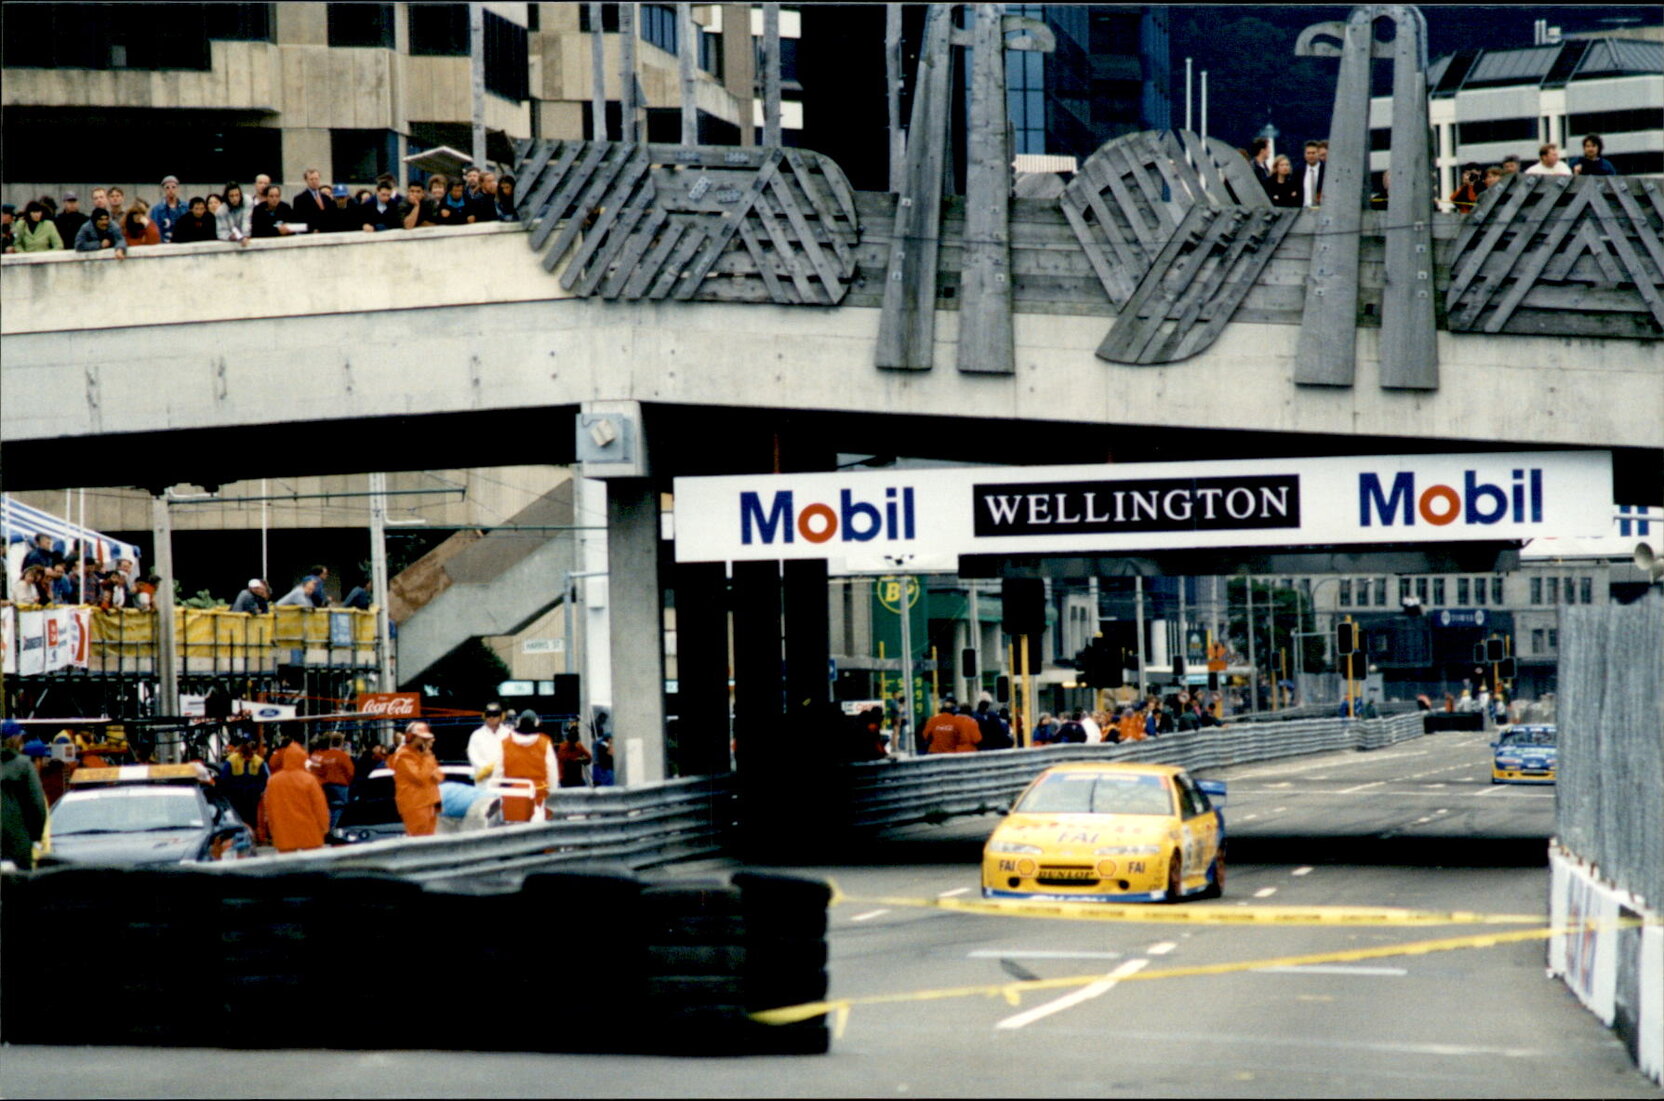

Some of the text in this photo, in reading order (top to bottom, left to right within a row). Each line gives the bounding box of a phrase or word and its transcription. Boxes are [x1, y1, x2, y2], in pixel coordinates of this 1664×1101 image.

[1359, 468, 1543, 527] Mobil
[984, 486, 1290, 527] WELLINGTON
[740, 486, 916, 545] Mobil
[362, 698, 415, 715] Coca-Cola
[1057, 831, 1099, 844] FAI
[1000, 860, 1016, 872] FAI
[1128, 862, 1146, 874] FAI
[1038, 870, 1094, 879] DUNLOP
